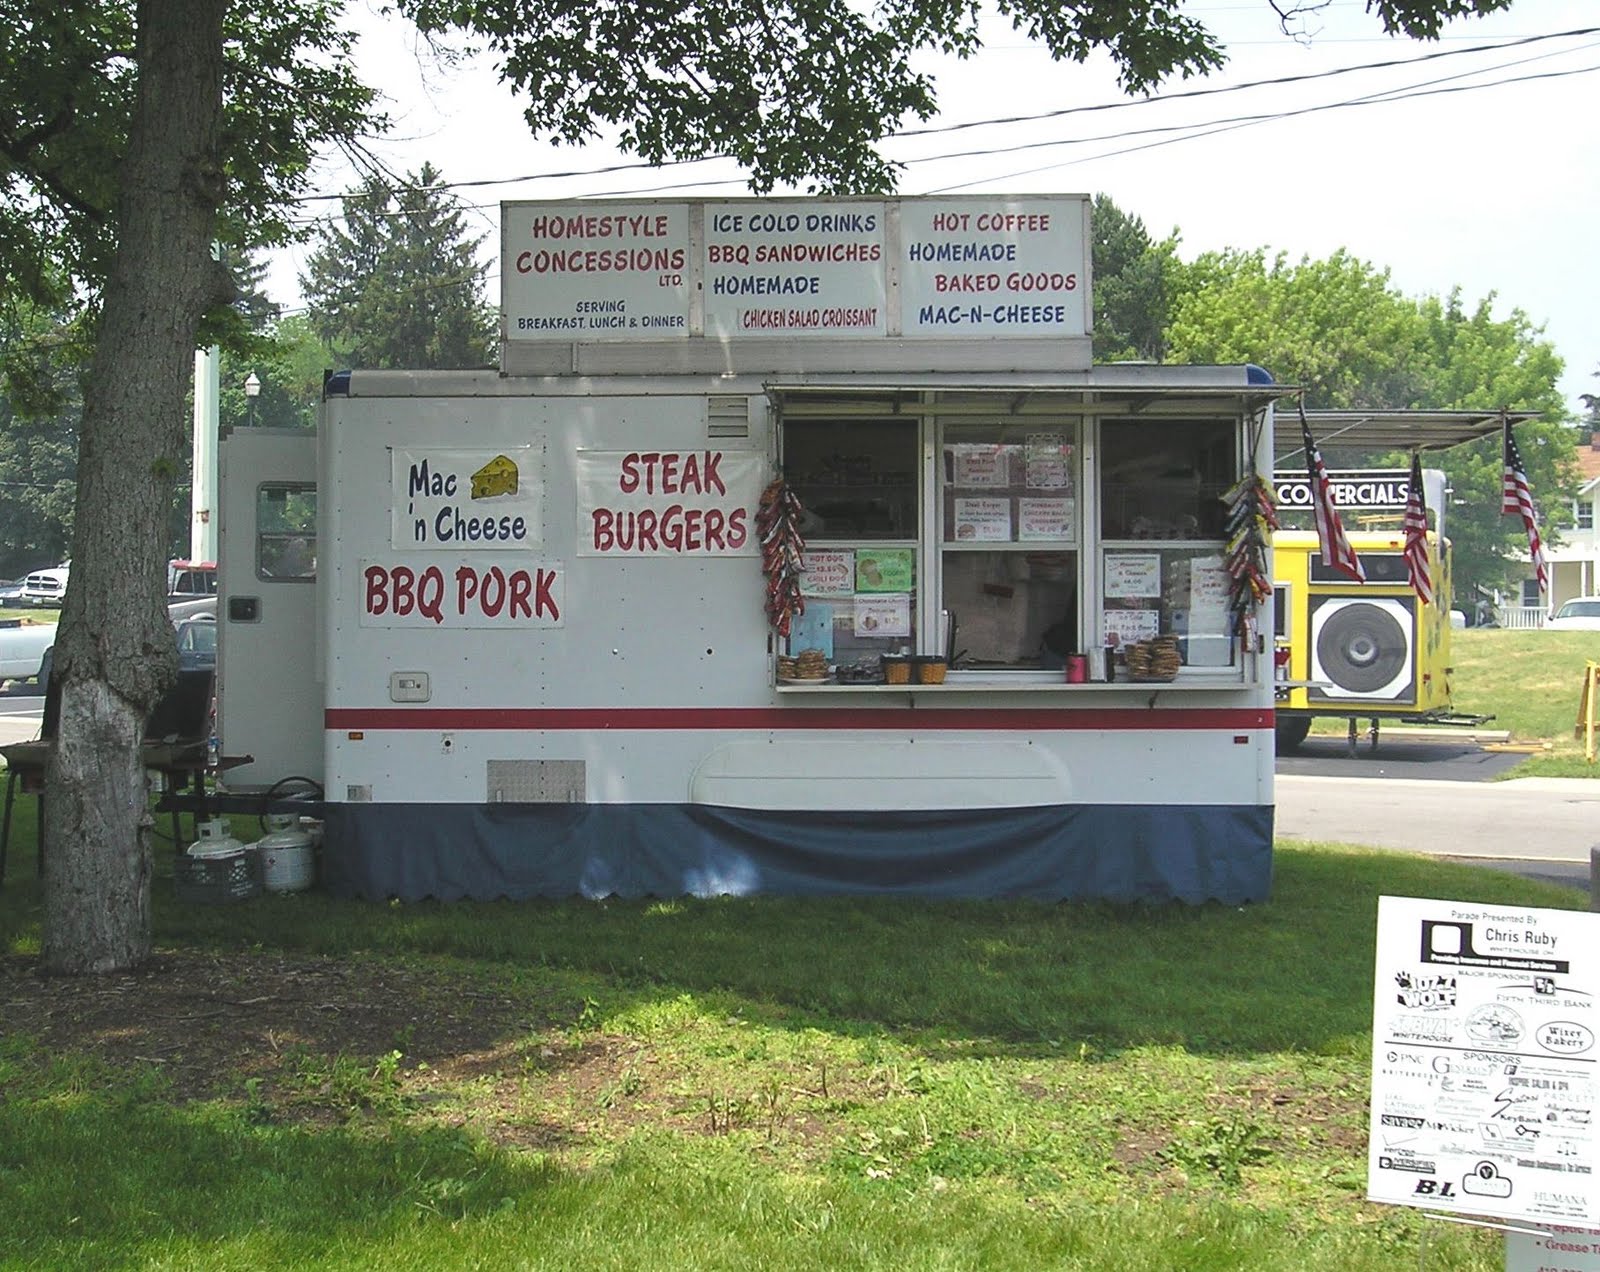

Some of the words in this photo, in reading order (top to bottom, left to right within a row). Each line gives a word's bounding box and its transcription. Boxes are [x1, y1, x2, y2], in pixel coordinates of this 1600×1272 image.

[533, 214, 668, 239] HOMESTYLE
[713, 214, 743, 232] ICE
[749, 213, 800, 232] COLD
[806, 214, 876, 233] DRINKS
[933, 213, 970, 231] HOT
[977, 213, 1050, 231] COFFEE
[516, 248, 685, 274] CONCESSIONS
[708, 245, 749, 265] BBQ
[755, 243, 881, 262] SANDWICHES
[909, 242, 1016, 262] HOMEMADE
[659, 275, 683, 287] LTD.
[713, 275, 820, 295] HOMEMADE
[935, 273, 1000, 292] BAKED
[1006, 272, 1077, 292] GOODS
[576, 300, 625, 313] SERVING
[919, 304, 1065, 325] MAC-N-CHEESE
[590, 315, 625, 328] LUNCH
[629, 317, 638, 328] &
[641, 315, 684, 328] DINNER
[743, 308, 785, 328] CHICKEN
[788, 309, 819, 328] SALAD
[822, 307, 877, 327] CROISSANT
[408, 458, 457, 498] Mac
[620, 450, 726, 496] STEAK
[408, 502, 426, 542] 'n
[434, 506, 527, 542] Cheese
[592, 504, 747, 552] BURGERS
[364, 565, 444, 624] BBQ
[455, 565, 560, 621] PORK
[1451, 909, 1480, 921] Parade
[1482, 912, 1525, 925] Presented
[1526, 914, 1538, 926] By
[1485, 928, 1519, 943] Chris
[1525, 930, 1558, 949] Ruby
[1403, 990, 1457, 1009] WOLF
[1463, 1051, 1522, 1065] SPONSORS
[1545, 1239, 1589, 1254] Grease
